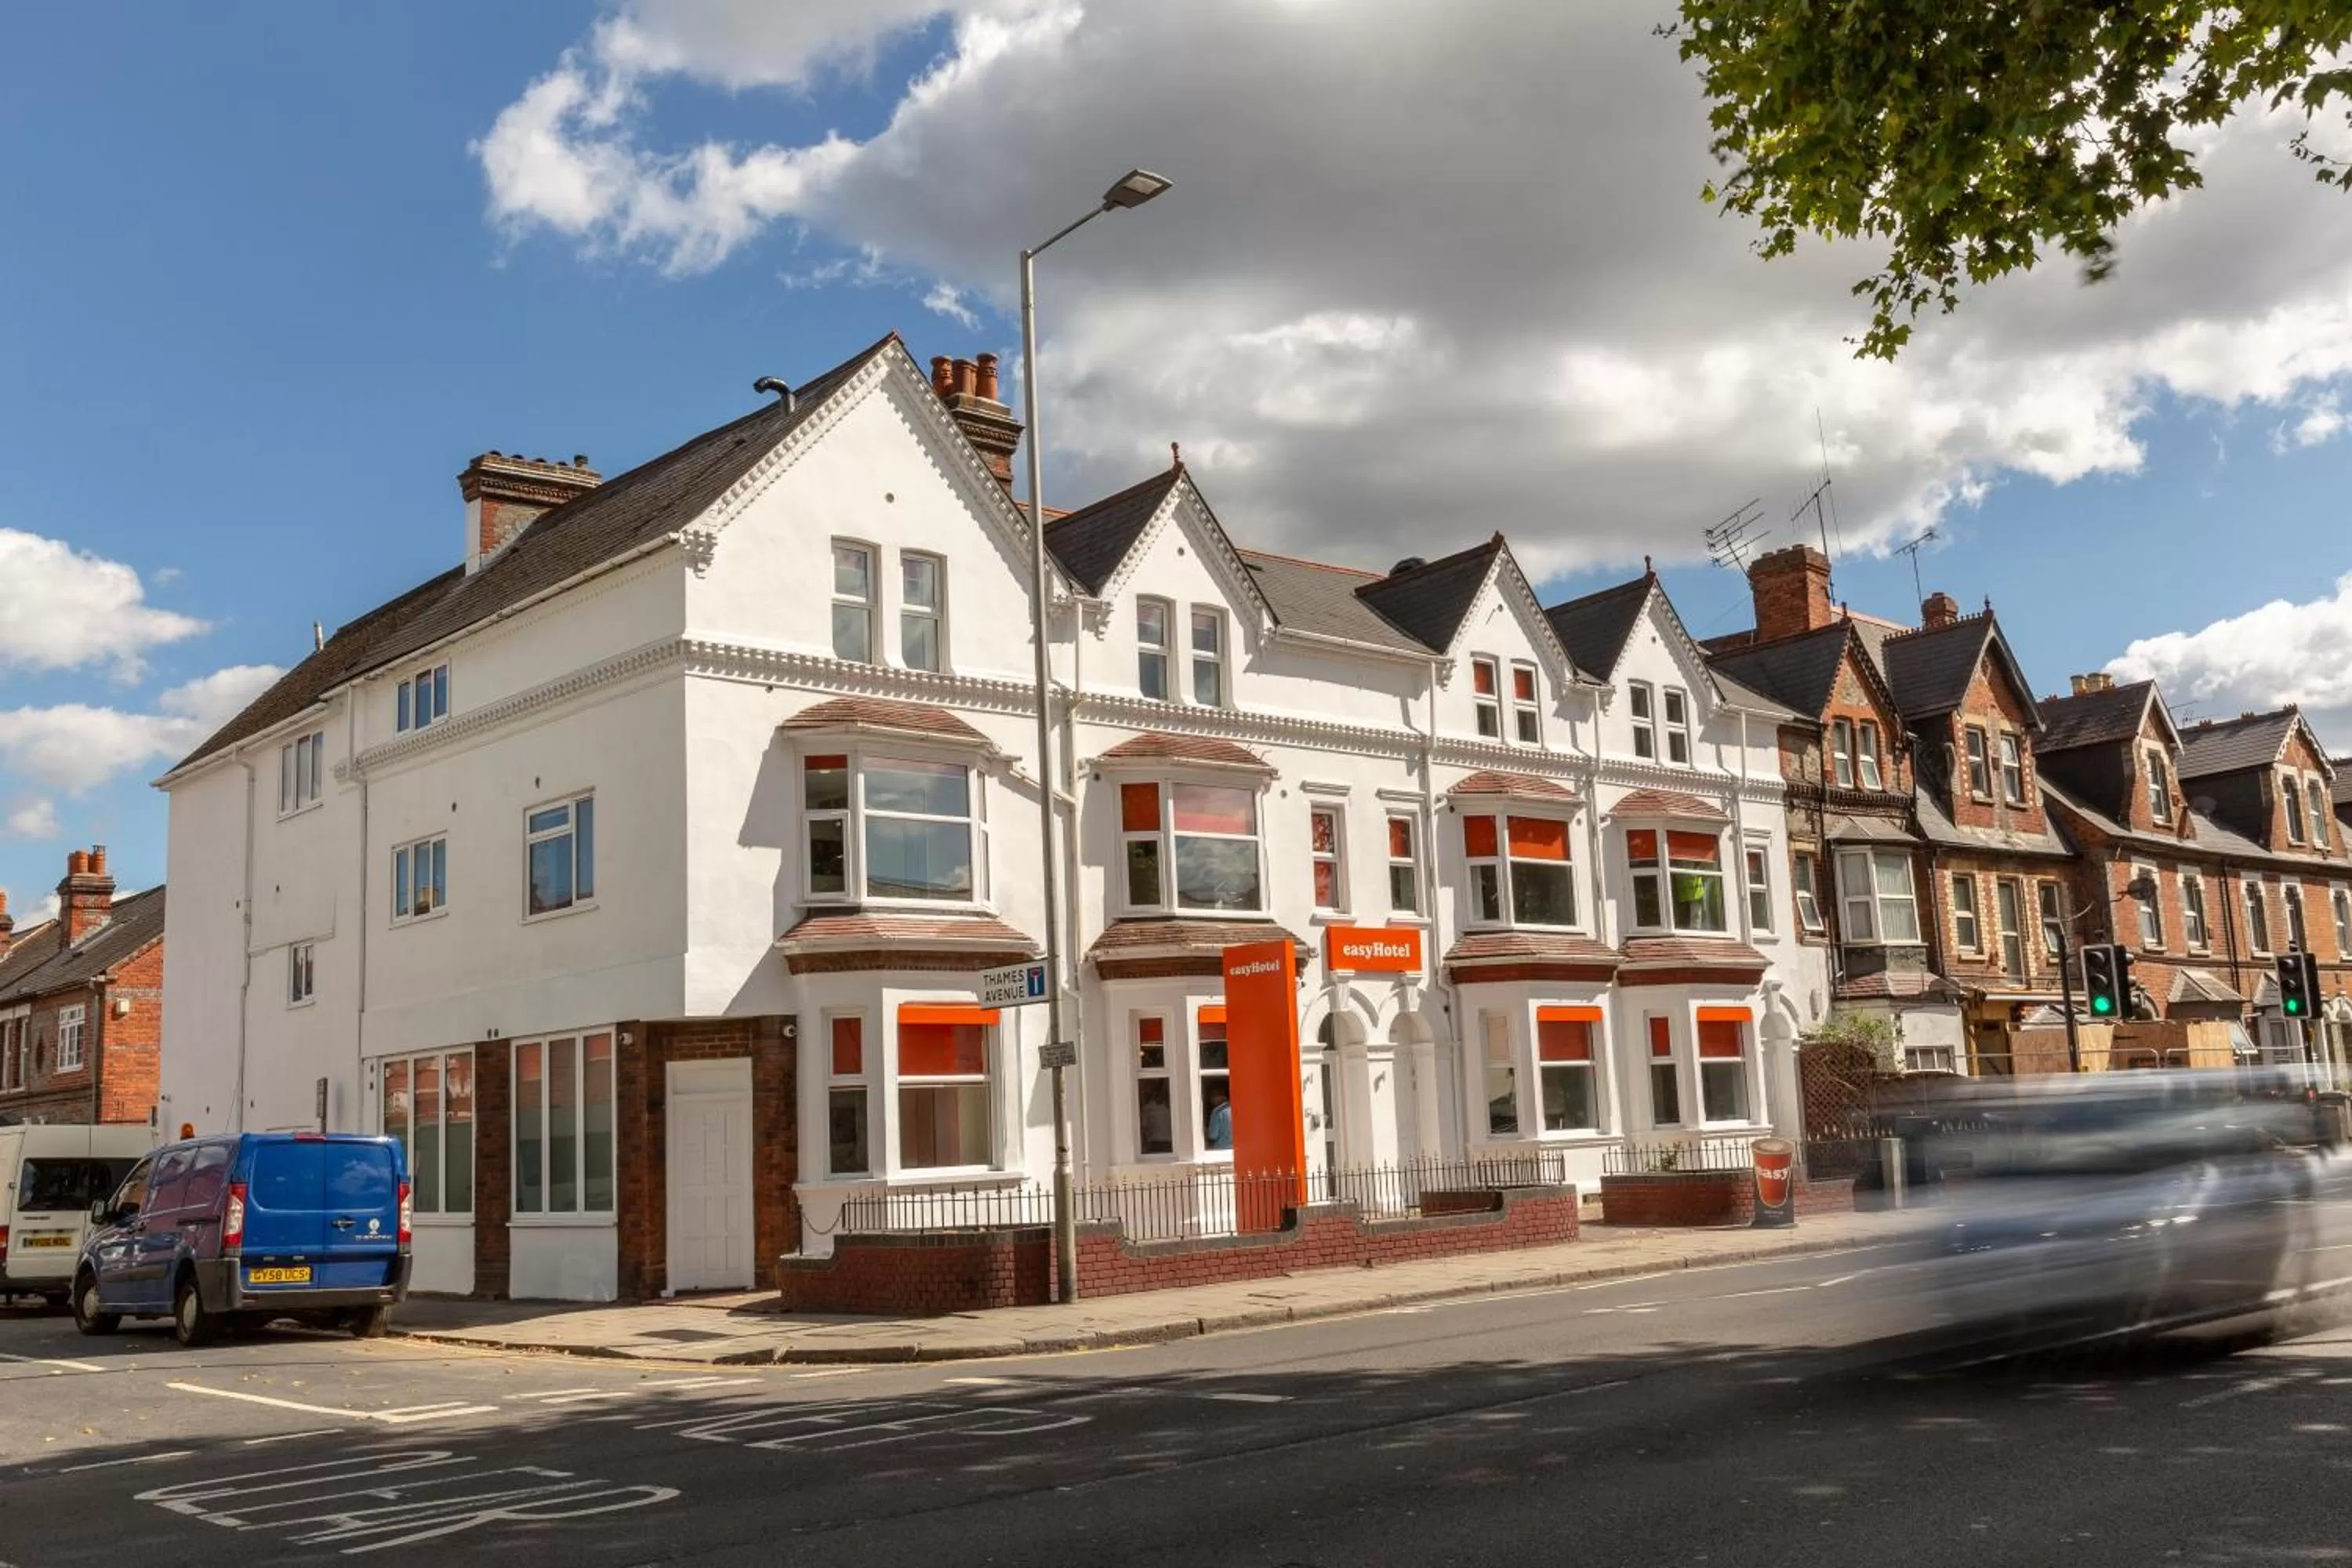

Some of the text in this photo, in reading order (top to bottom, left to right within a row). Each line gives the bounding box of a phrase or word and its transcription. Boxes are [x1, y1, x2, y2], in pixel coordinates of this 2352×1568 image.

[1343, 941, 1411, 960] easyHotel
[983, 968, 1025, 987] THAMES
[1229, 959, 1280, 977] easyHotel
[985, 985, 1025, 1002] AVENUE
[133, 1451, 682, 1554] CLEAR
